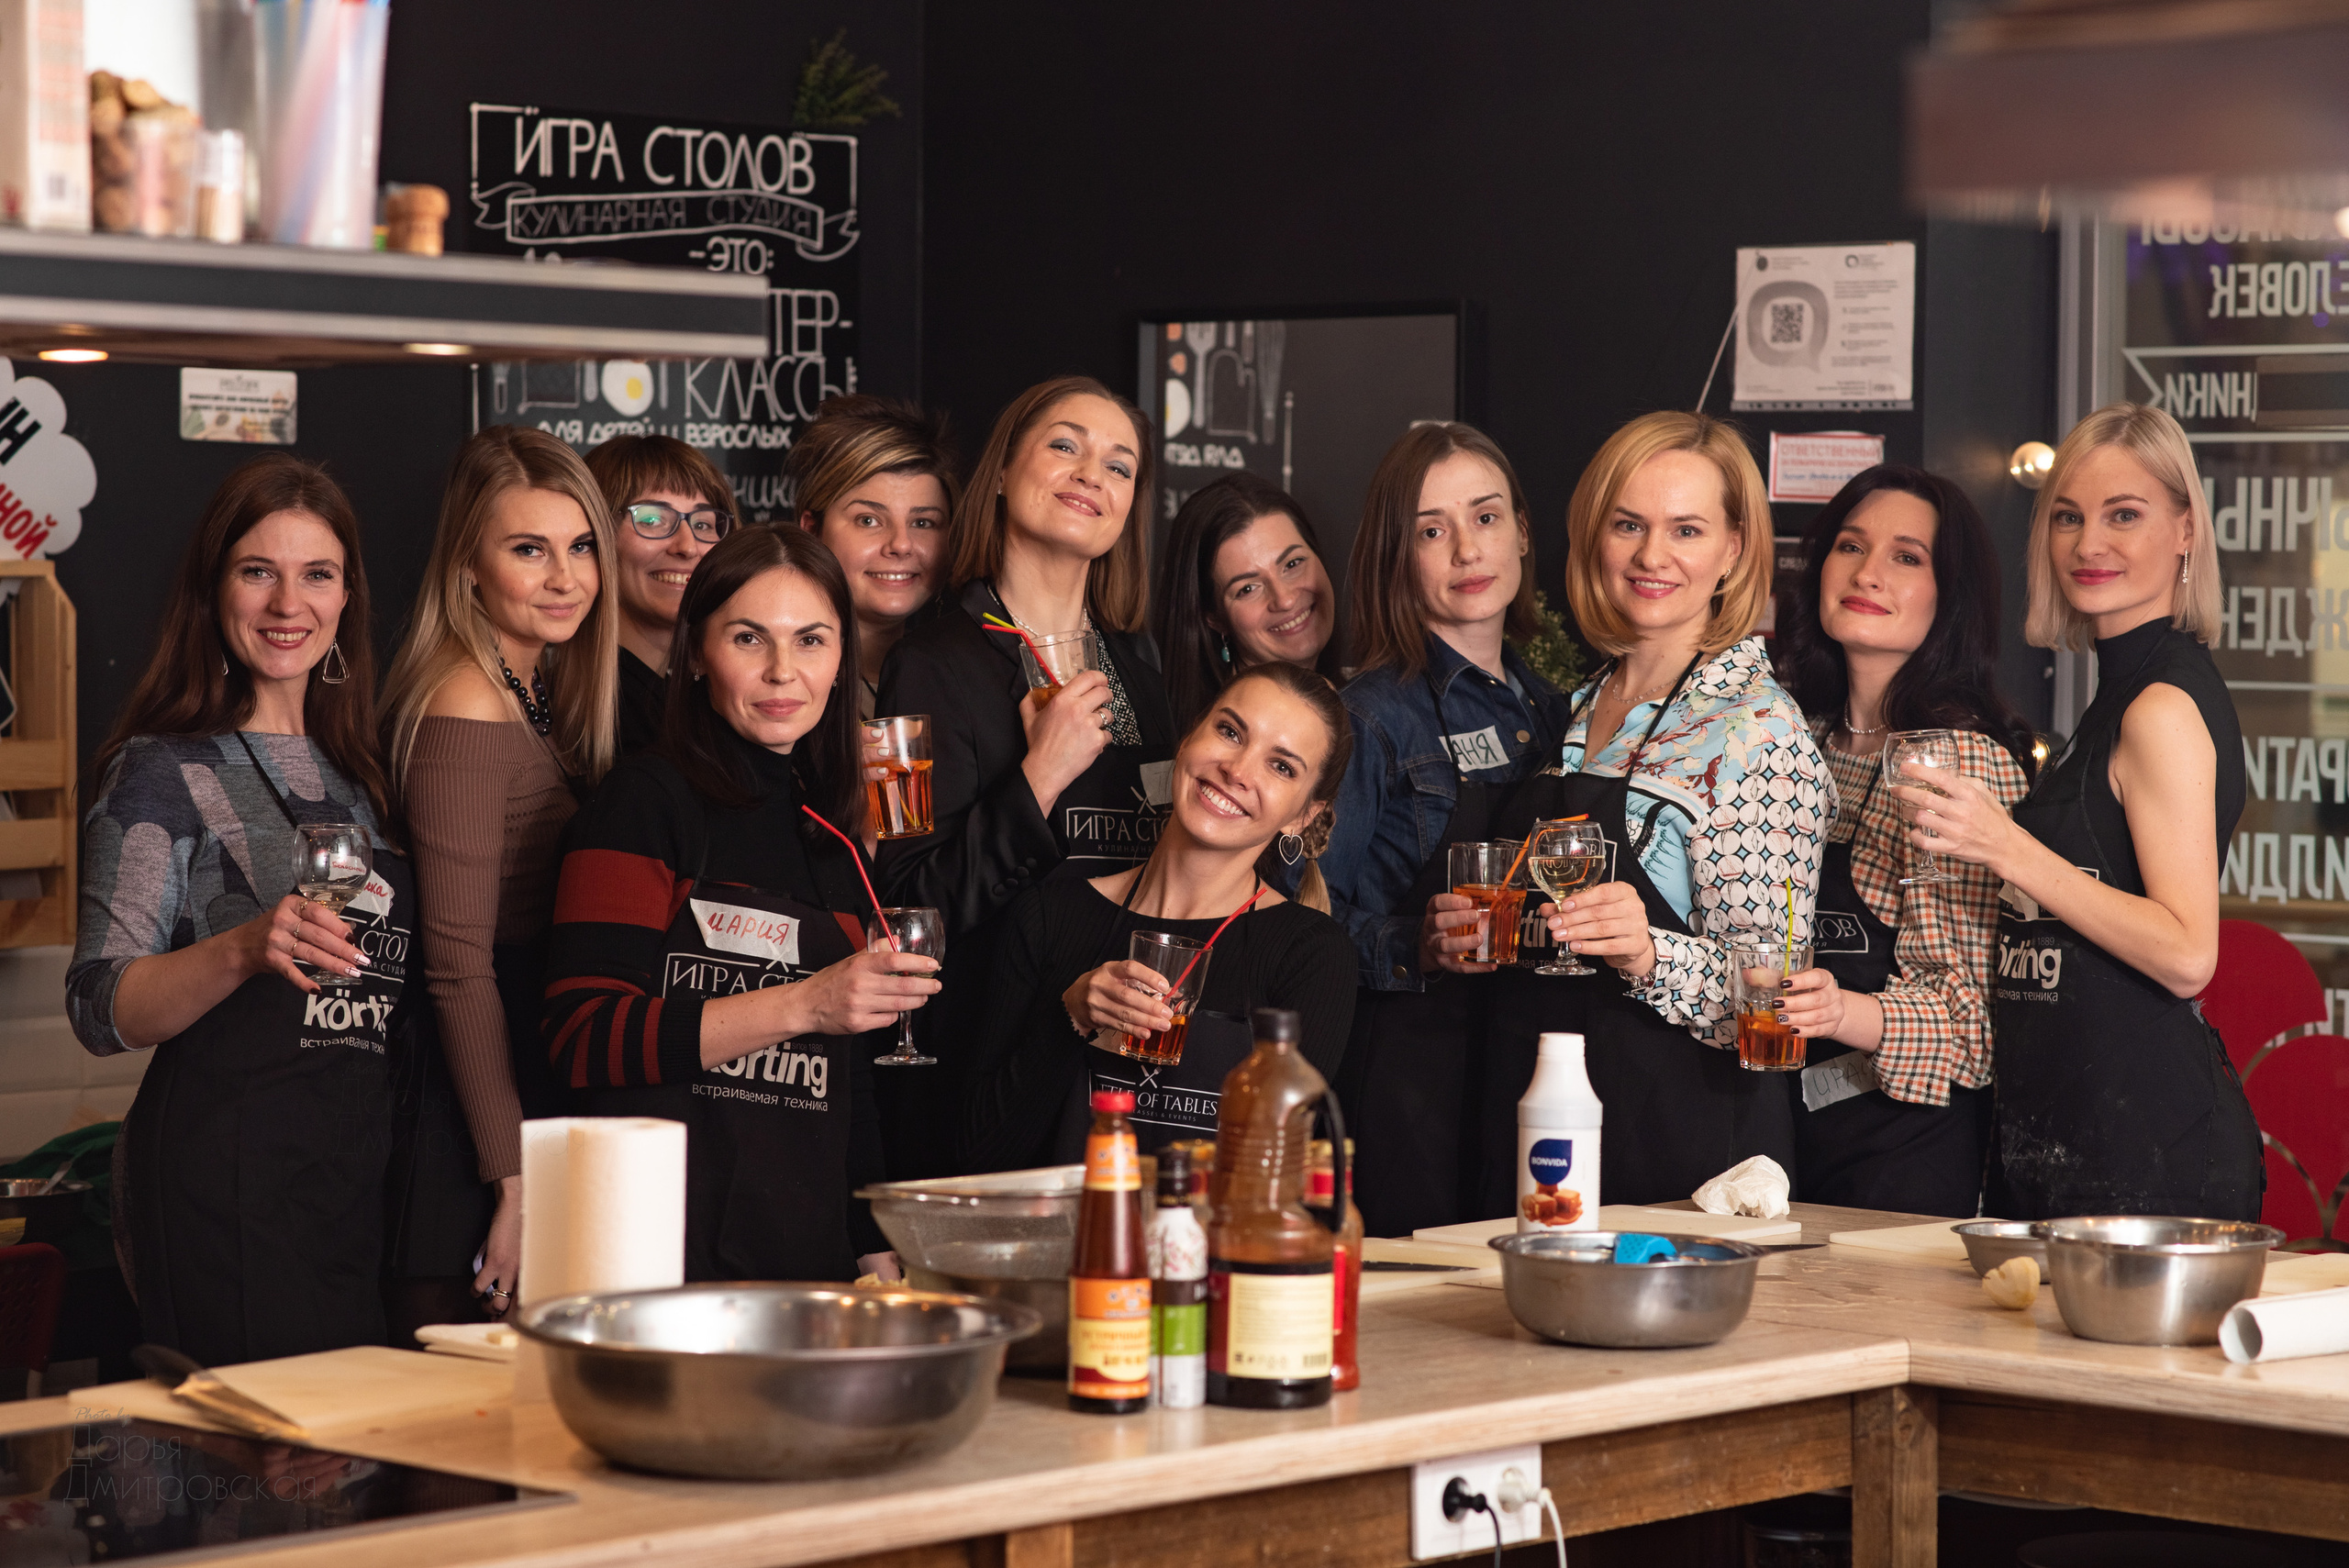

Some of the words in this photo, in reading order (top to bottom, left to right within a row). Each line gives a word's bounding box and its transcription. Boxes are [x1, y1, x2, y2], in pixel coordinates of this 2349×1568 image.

[515, 116, 625, 183] ИГРА
[643, 126, 816, 195] СТОЛОВ
[513, 196, 687, 237] КУЛИНАРНАЯ
[706, 195, 813, 236] СТУДИЯ
[768, 286, 853, 358] ТЕР-
[687, 420, 793, 450] ВЗРОСЛЫХ
[0, 484, 58, 561] НОЙ
[1452, 732, 1498, 766] АНЯ
[1074, 814, 1131, 841] ИГРА
[380, 962, 406, 975] СТУДИ
[672, 961, 748, 995] ИГРА
[371, 1041, 385, 1055] техн
[808, 1043, 823, 1053] 1889
[692, 1084, 779, 1106] встраиваемая
[783, 1096, 829, 1112] техника
[1138, 1092, 1159, 1107] OF
[1163, 1094, 1218, 1116] TABLES
[1168, 1113, 1197, 1122] EVENTS
[1531, 1156, 1568, 1167] BONVIDA
